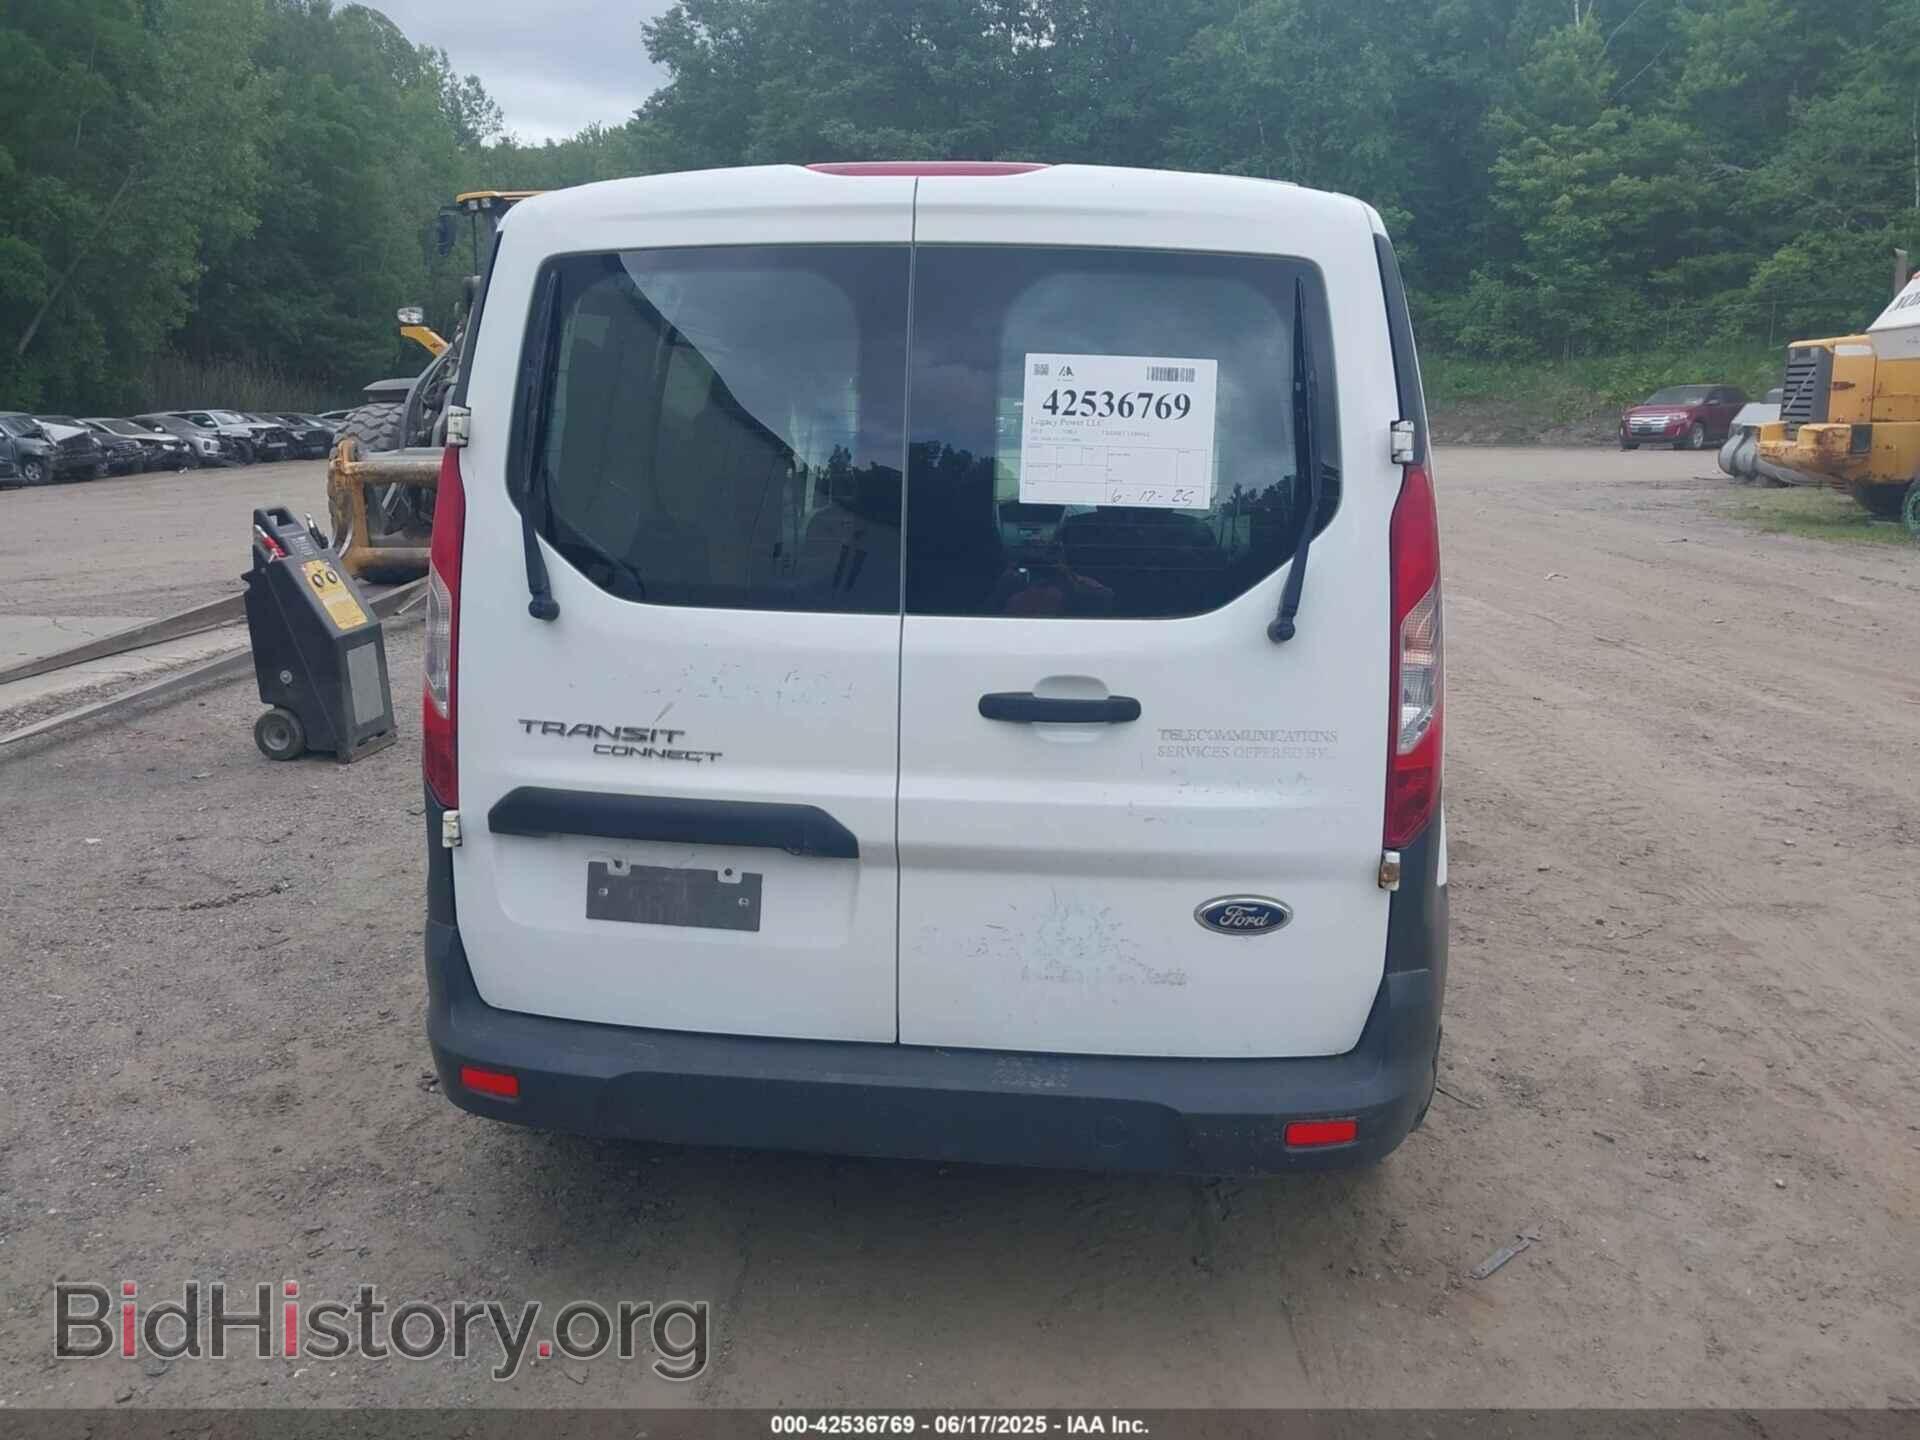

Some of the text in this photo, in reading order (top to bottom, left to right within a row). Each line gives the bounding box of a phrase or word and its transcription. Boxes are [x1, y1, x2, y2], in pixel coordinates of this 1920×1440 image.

[1042, 389, 1191, 420] 42536769
[518, 719, 686, 744] TRANSIT
[593, 744, 723, 762] CONNECT
[1157, 745, 1230, 759] SERVICES
[1219, 905, 1271, 926] Ford
